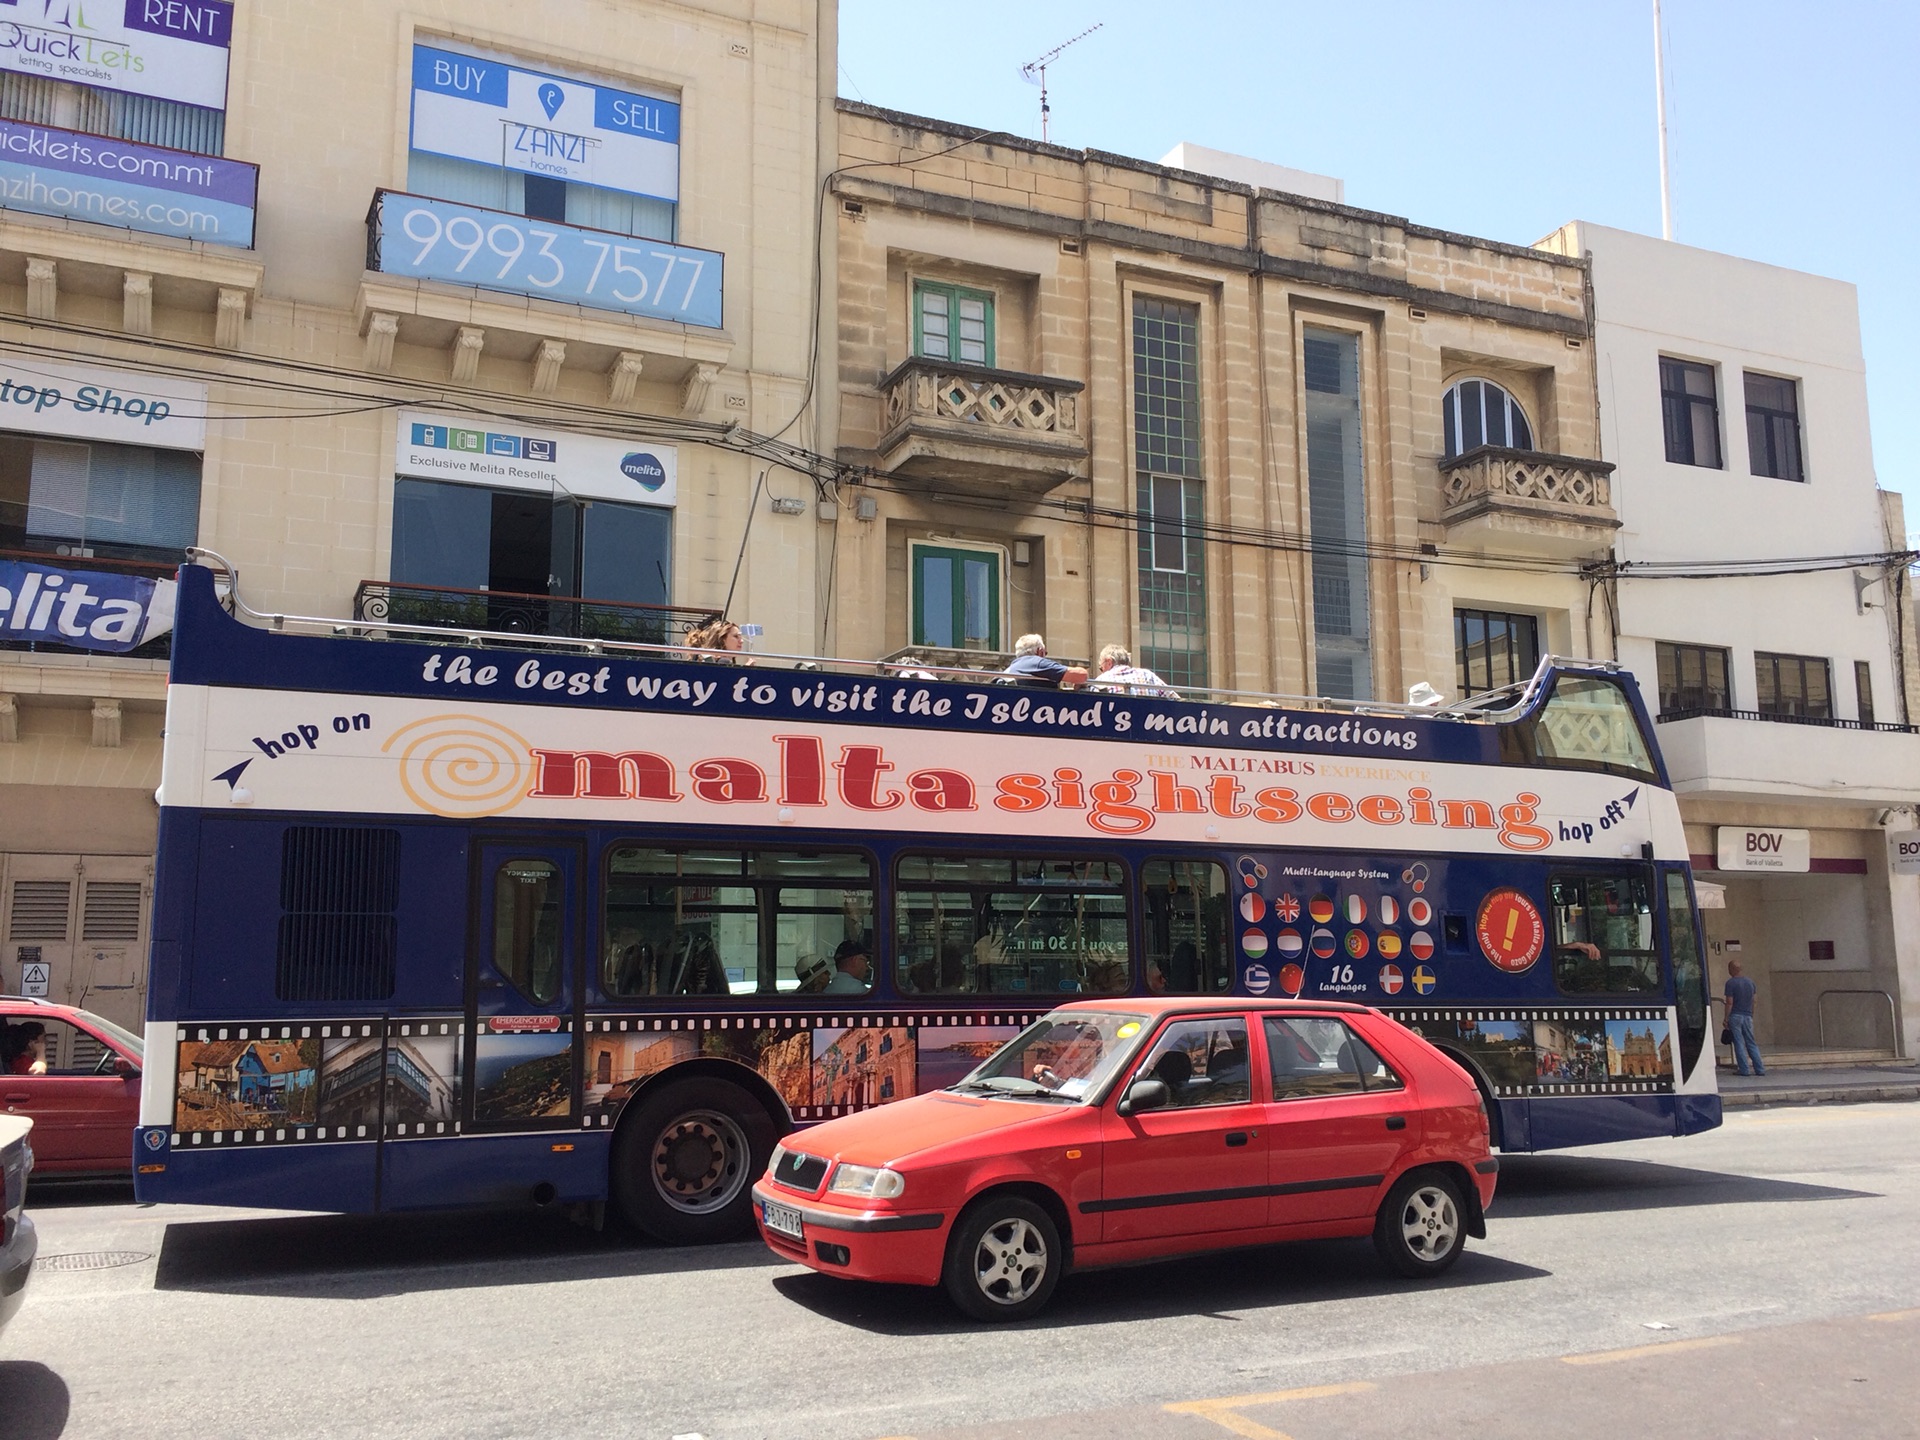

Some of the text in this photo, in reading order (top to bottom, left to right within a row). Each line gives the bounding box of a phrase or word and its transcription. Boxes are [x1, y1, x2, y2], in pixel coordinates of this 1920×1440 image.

[144, 0, 220, 36] RENT
[19, 54, 112, 81] letting specialists
[433, 59, 487, 94] BUY
[612, 100, 665, 134] SELL
[514, 123, 585, 164] ZANZI
[0, 127, 214, 187] icklets.com.mt
[530, 157, 568, 175] homes
[403, 209, 705, 311] 9993 7577
[73, 386, 170, 426] Shop
[410, 455, 556, 481] Exclusive Melita Reseller
[624, 463, 662, 477] melita
[422, 654, 1418, 750] the best way to visit the Island's main attractions
[252, 713, 371, 759] hop on
[1145, 753, 1431, 783] THE MALTABUS EXPERIENCE
[527, 734, 1553, 852] malta sightseeing
[1558, 800, 1625, 843] hop off
[1746, 832, 1783, 852] BOV
[1899, 842, 1920, 855] BO
[1283, 867, 1389, 879] Multi-Language System
[1765, 859, 1783, 867] Valletta
[1515, 893, 1531, 911] Tours
[1480, 913, 1489, 930] Hop
[1529, 909, 1536, 919] in
[1482, 932, 1492, 949] only
[1532, 920, 1540, 944] Malta
[1491, 949, 1502, 963] The
[1510, 955, 1527, 966] Gozo
[1526, 944, 1536, 960] and
[1331, 965, 1354, 984] 16
[1319, 983, 1367, 993] Languages
